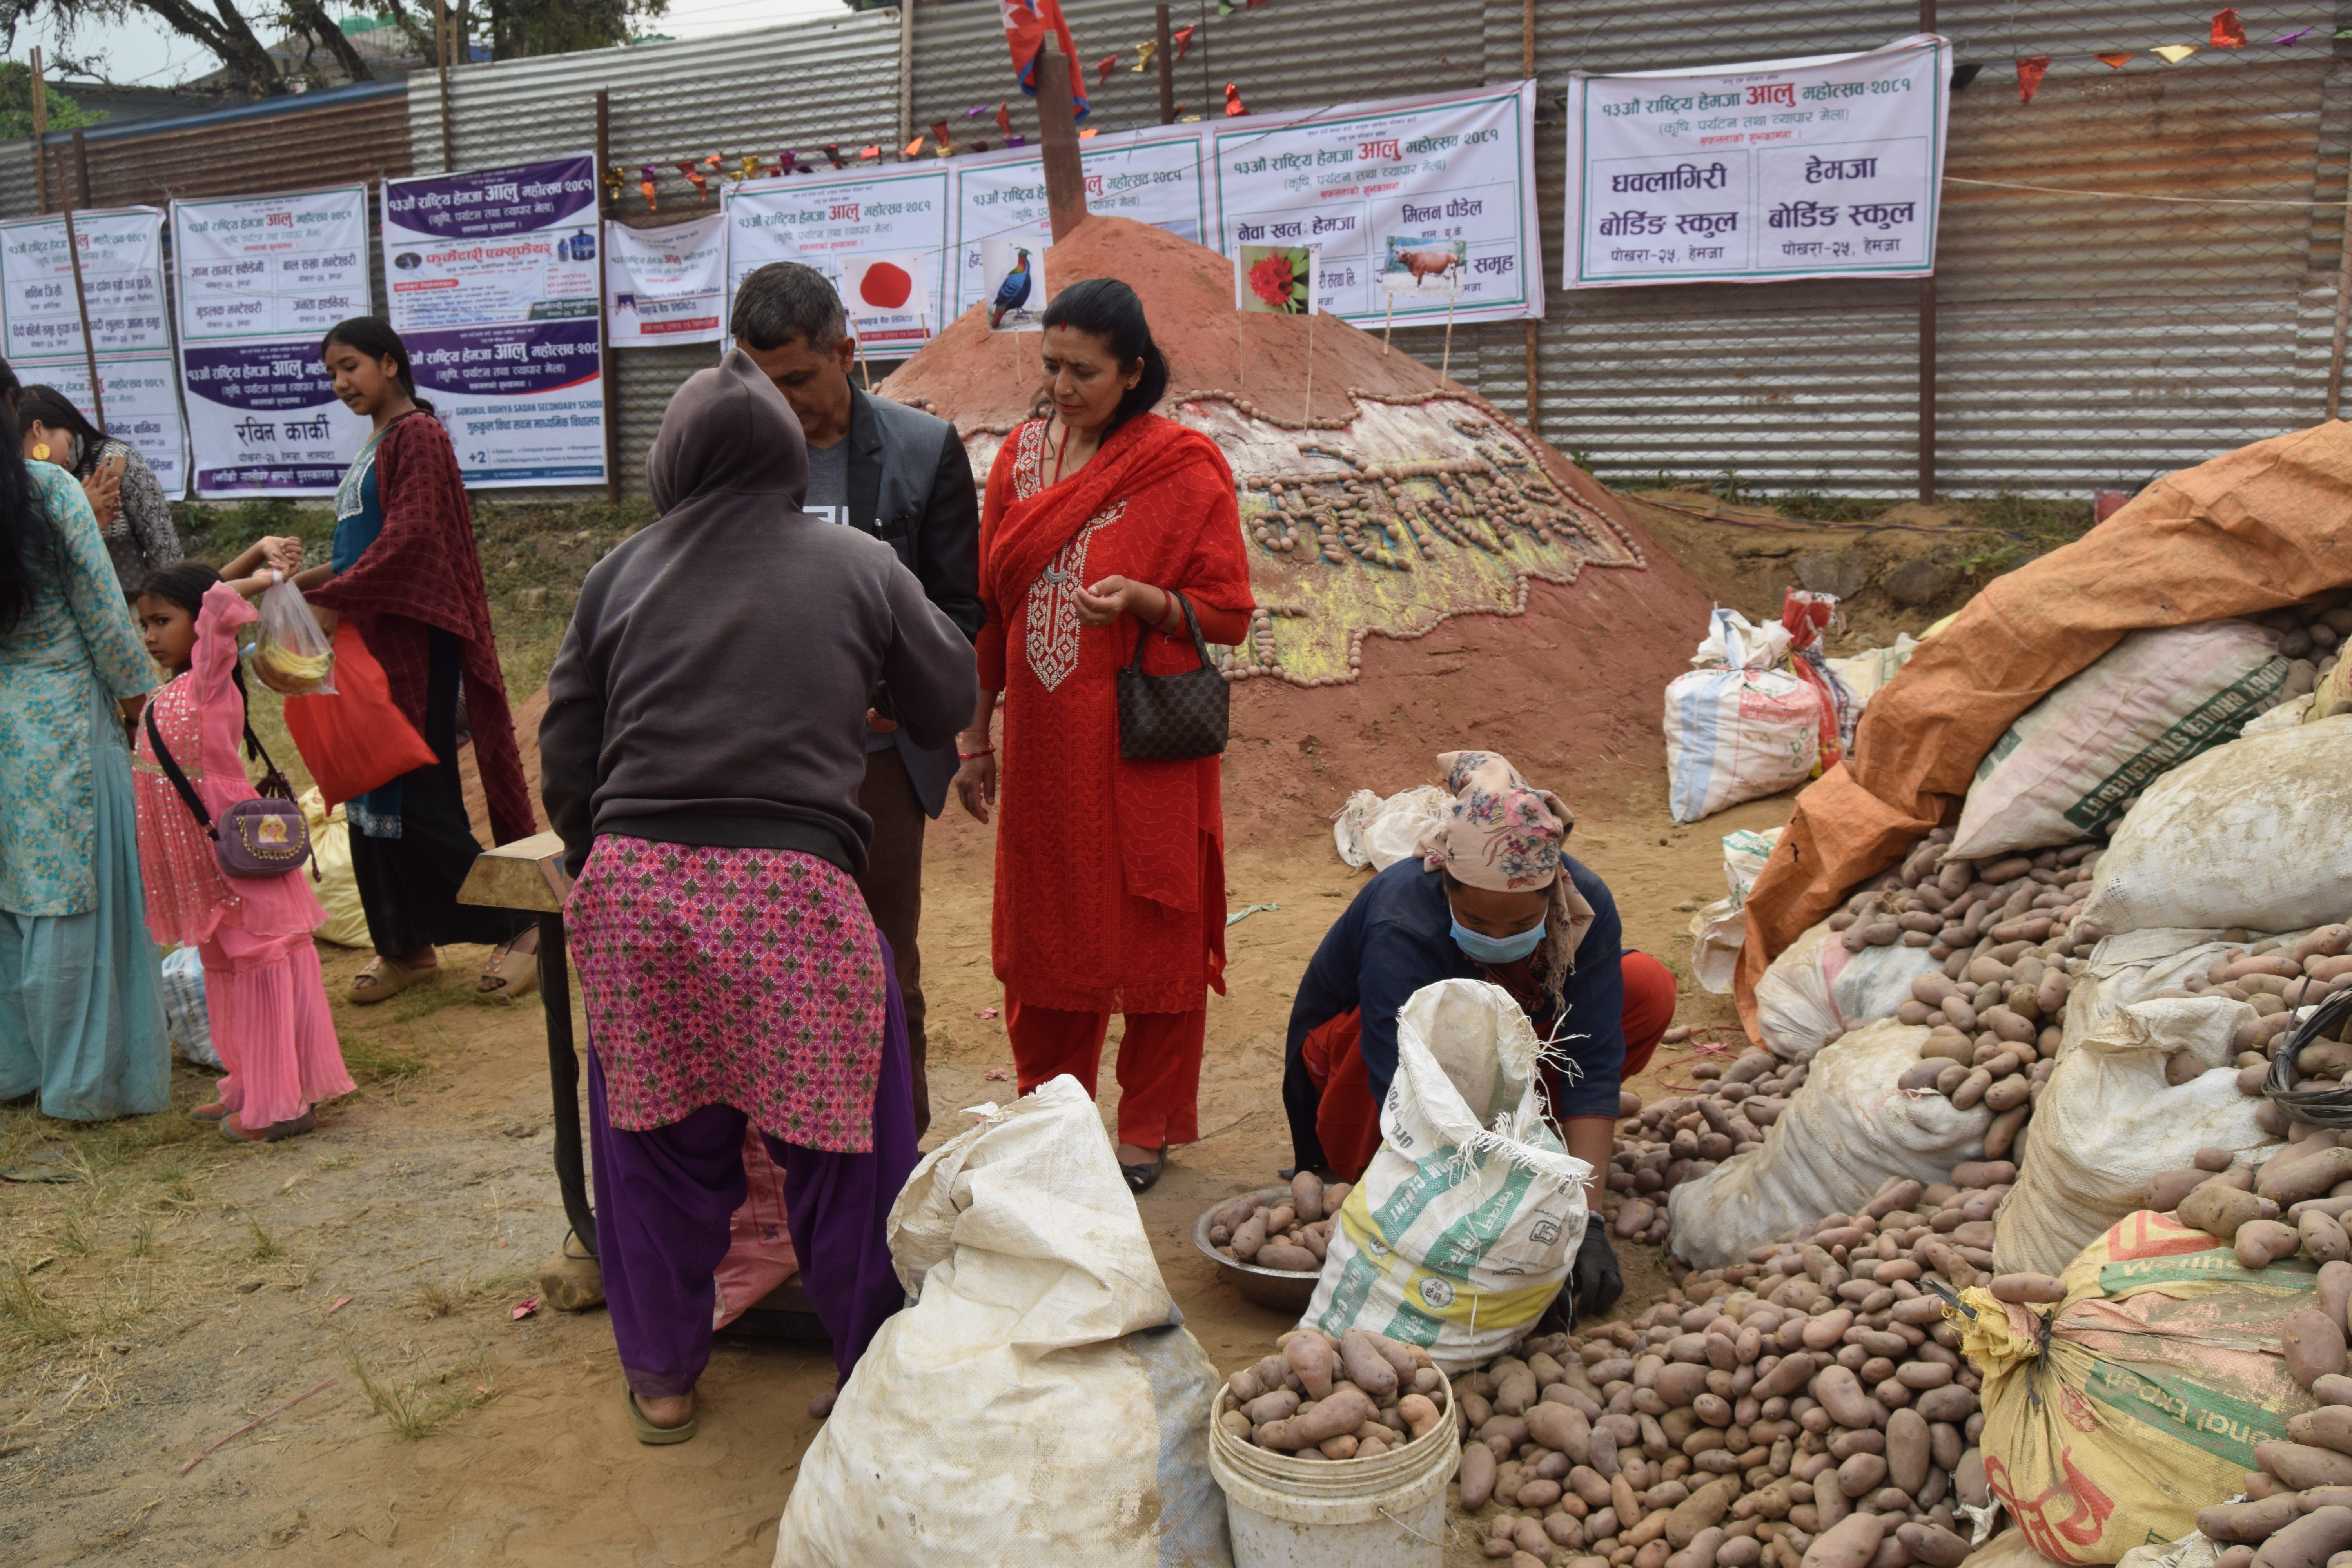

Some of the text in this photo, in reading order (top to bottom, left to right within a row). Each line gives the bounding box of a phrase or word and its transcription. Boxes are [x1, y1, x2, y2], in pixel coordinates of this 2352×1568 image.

[1698, 92, 1741, 110] हेमजा
[1746, 83, 1796, 107] आलु
[1699, 117, 1737, 130] पर्यटन
[1744, 116, 1766, 128] तथा
[1772, 111, 1813, 124] व्यापार
[1820, 107, 1849, 122] मेला)
[1317, 149, 1353, 166] हेमजा
[1358, 138, 1401, 161] आलु
[1318, 171, 1351, 185] पर्यटन
[1356, 169, 1377, 181] तथा
[1382, 164, 1417, 177] व्यापार
[1422, 159, 1446, 171] मेला)
[1805, 155, 1878, 184] हेमजा
[453, 190, 482, 206] हेमजा
[484, 183, 520, 203] आलु
[266, 212, 294, 228] आलु
[799, 209, 826, 225] हेमजा
[829, 202, 860, 223] आलु
[1403, 198, 1482, 223] मिलन पौडेल
[1848, 201, 1916, 230] स्कुल
[826, 227, 841, 238] तथा
[1238, 223, 1265, 241] नेवा
[1312, 215, 1356, 235] हेमजा
[1675, 211, 1739, 238] स्कुल
[1689, 245, 1724, 261] हेमजा
[1864, 237, 1901, 254] हेमजा
[1474, 254, 1515, 274] समूह
[462, 347, 492, 363] हेमजा
[494, 342, 529, 362] आलु
[243, 364, 270, 378] हेमजा
[271, 359, 303, 380] आलु
[578, 400, 602, 409] SCHOO
[234, 414, 330, 447] रविन कार्की
[2186, 691, 2246, 737] BROILER
[1388, 1174, 1426, 1223] CEMENT
